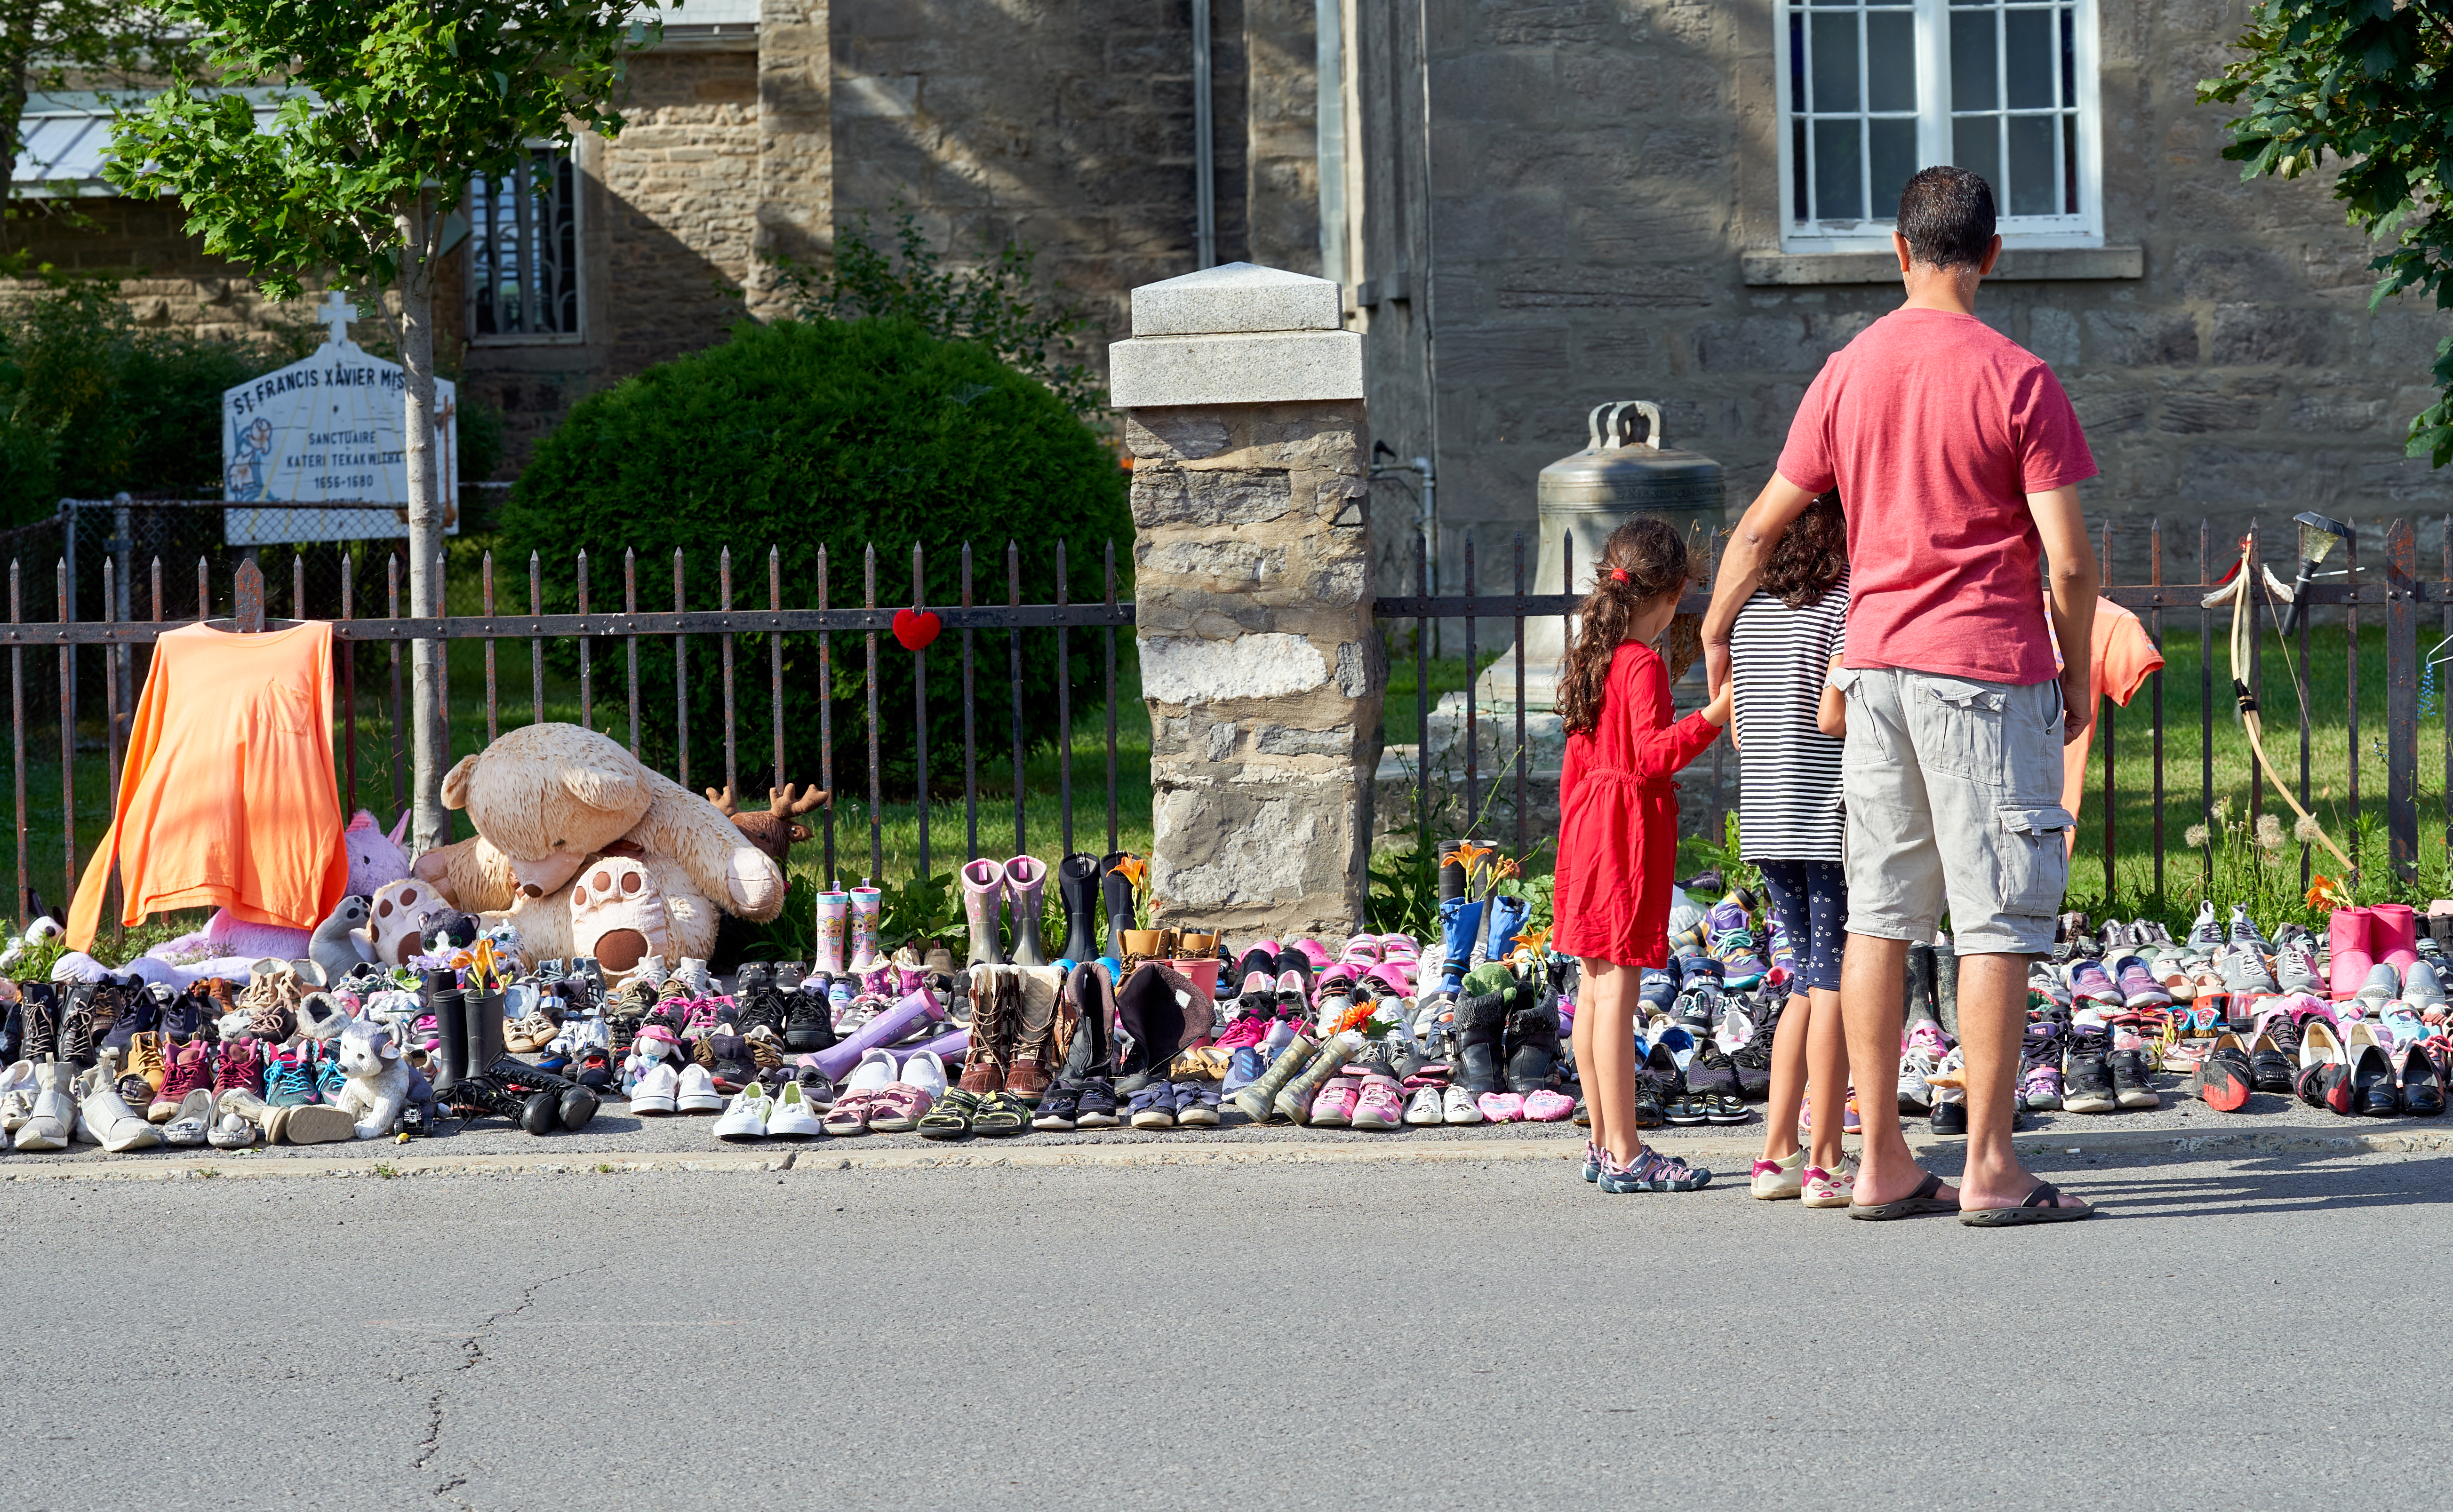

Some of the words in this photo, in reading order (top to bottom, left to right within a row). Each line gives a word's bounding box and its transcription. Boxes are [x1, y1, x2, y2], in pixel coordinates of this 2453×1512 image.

[256, 370, 319, 402] FRANCIS
[325, 368, 375, 386] XAVIER
[309, 430, 376, 445] SANCTUAIRE
[287, 454, 327, 468] KATERI
[332, 451, 401, 466] TEKAKWITHA
[315, 474, 374, 489] 1656-1680
